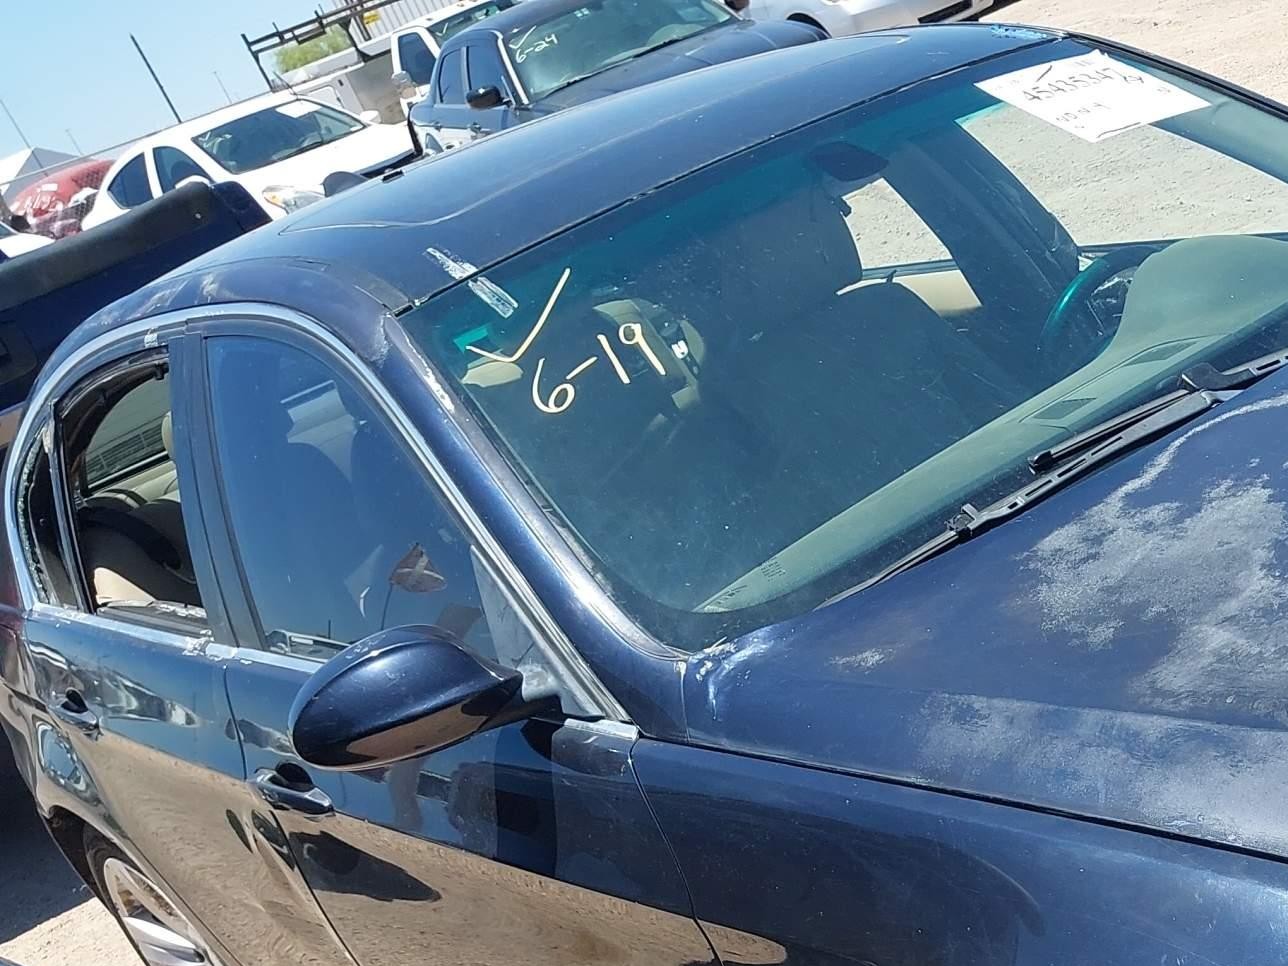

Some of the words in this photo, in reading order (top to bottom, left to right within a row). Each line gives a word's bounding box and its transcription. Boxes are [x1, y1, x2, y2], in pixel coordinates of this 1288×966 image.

[515, 33, 558, 64] 6-24
[1022, 67, 1121, 102] 45435347
[532, 322, 667, 414] 6-19
